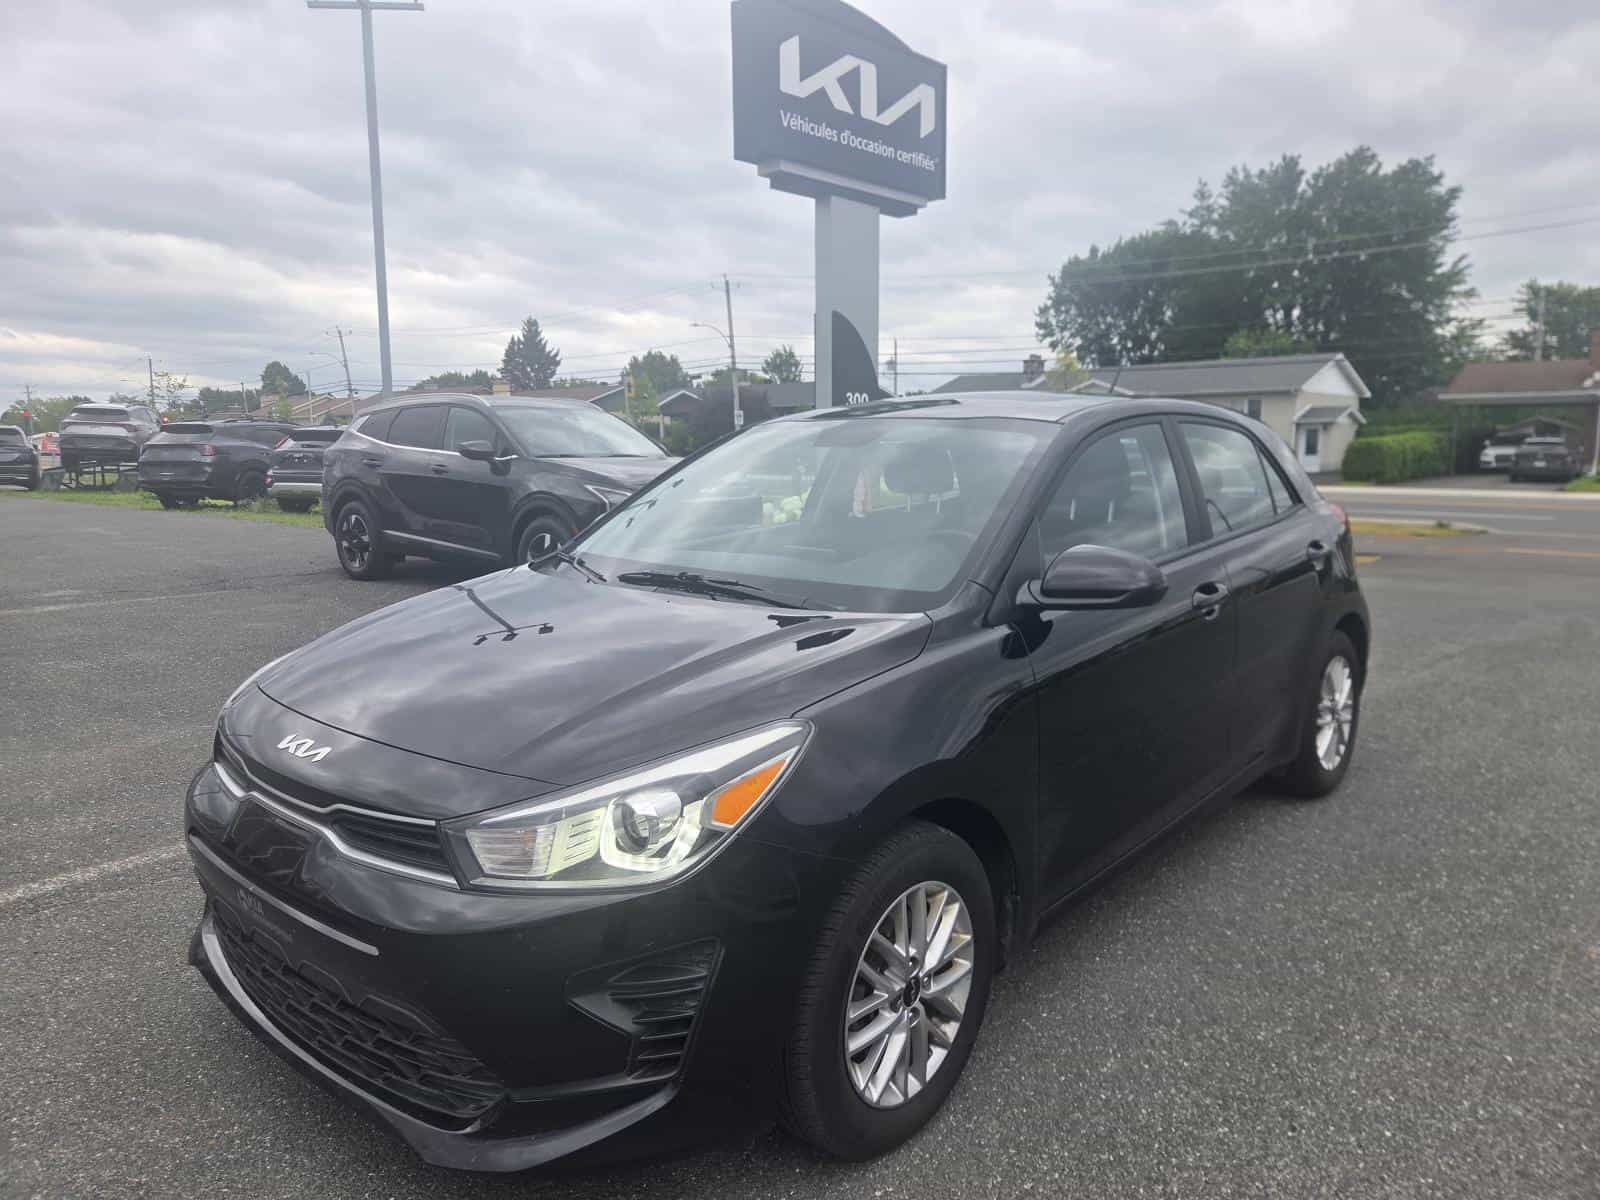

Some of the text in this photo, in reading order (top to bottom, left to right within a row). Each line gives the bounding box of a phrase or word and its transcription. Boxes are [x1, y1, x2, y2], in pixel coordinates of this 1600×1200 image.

[779, 34, 935, 139] KIA
[780, 109, 838, 141] Véhicules
[840, 129, 895, 160] d'occasion
[845, 391, 869, 406] 300
[277, 734, 332, 762] KIA
